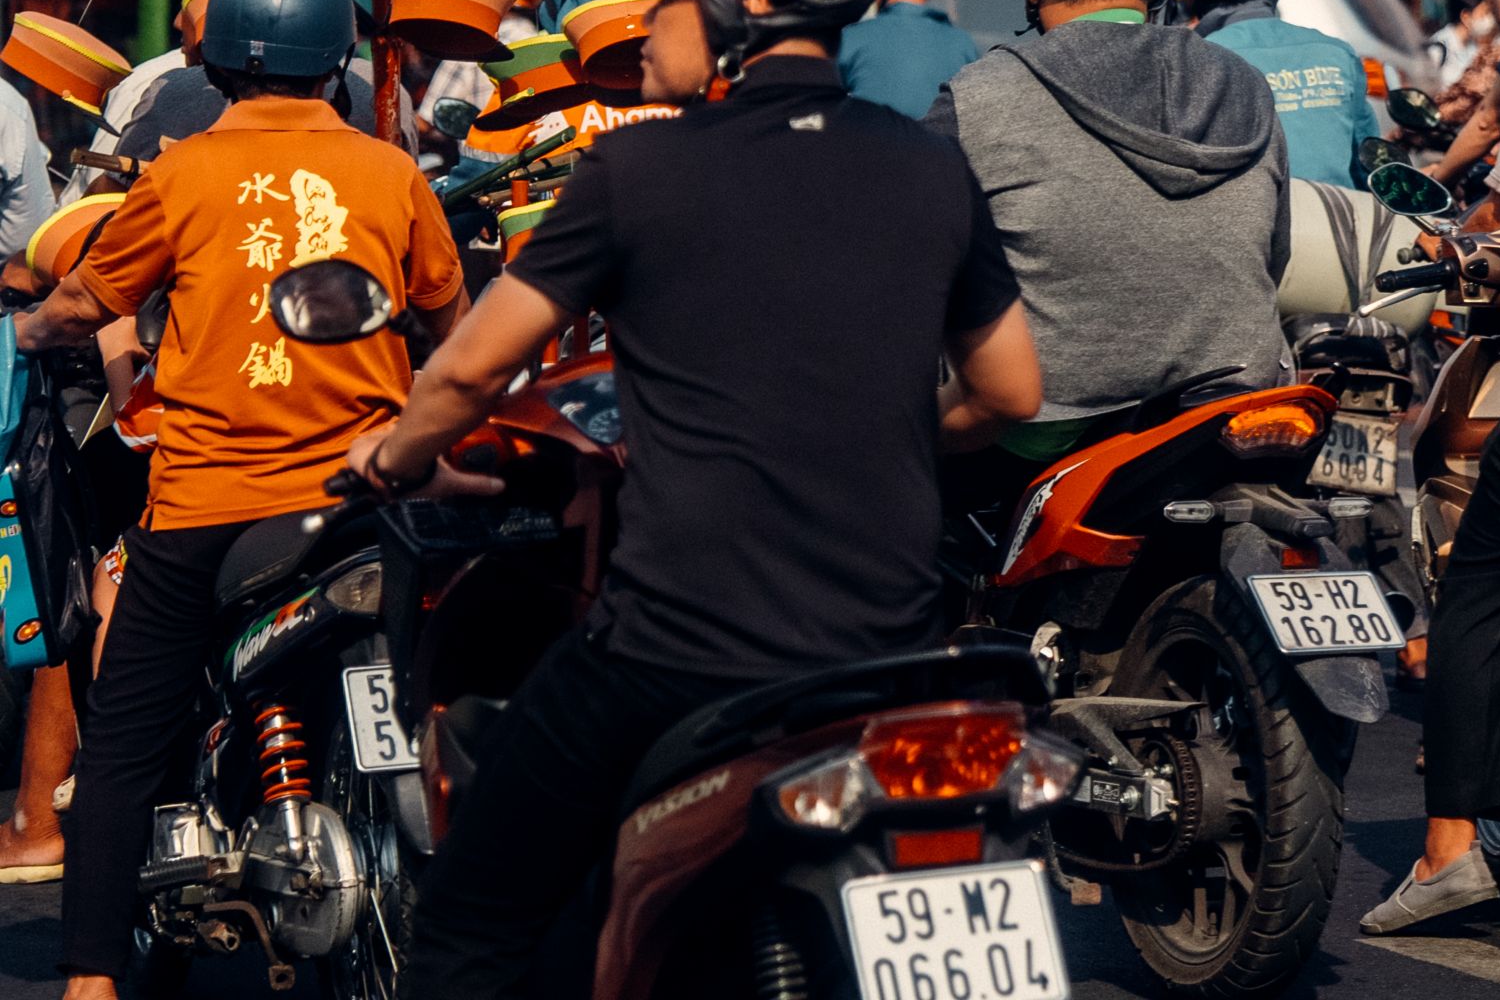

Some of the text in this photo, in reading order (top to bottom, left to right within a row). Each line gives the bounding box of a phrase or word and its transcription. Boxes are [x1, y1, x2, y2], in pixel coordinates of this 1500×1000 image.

[1270, 579, 1368, 612] 59-H2
[1281, 612, 1392, 647] 162.80
[877, 877, 1019, 944] 59-M2
